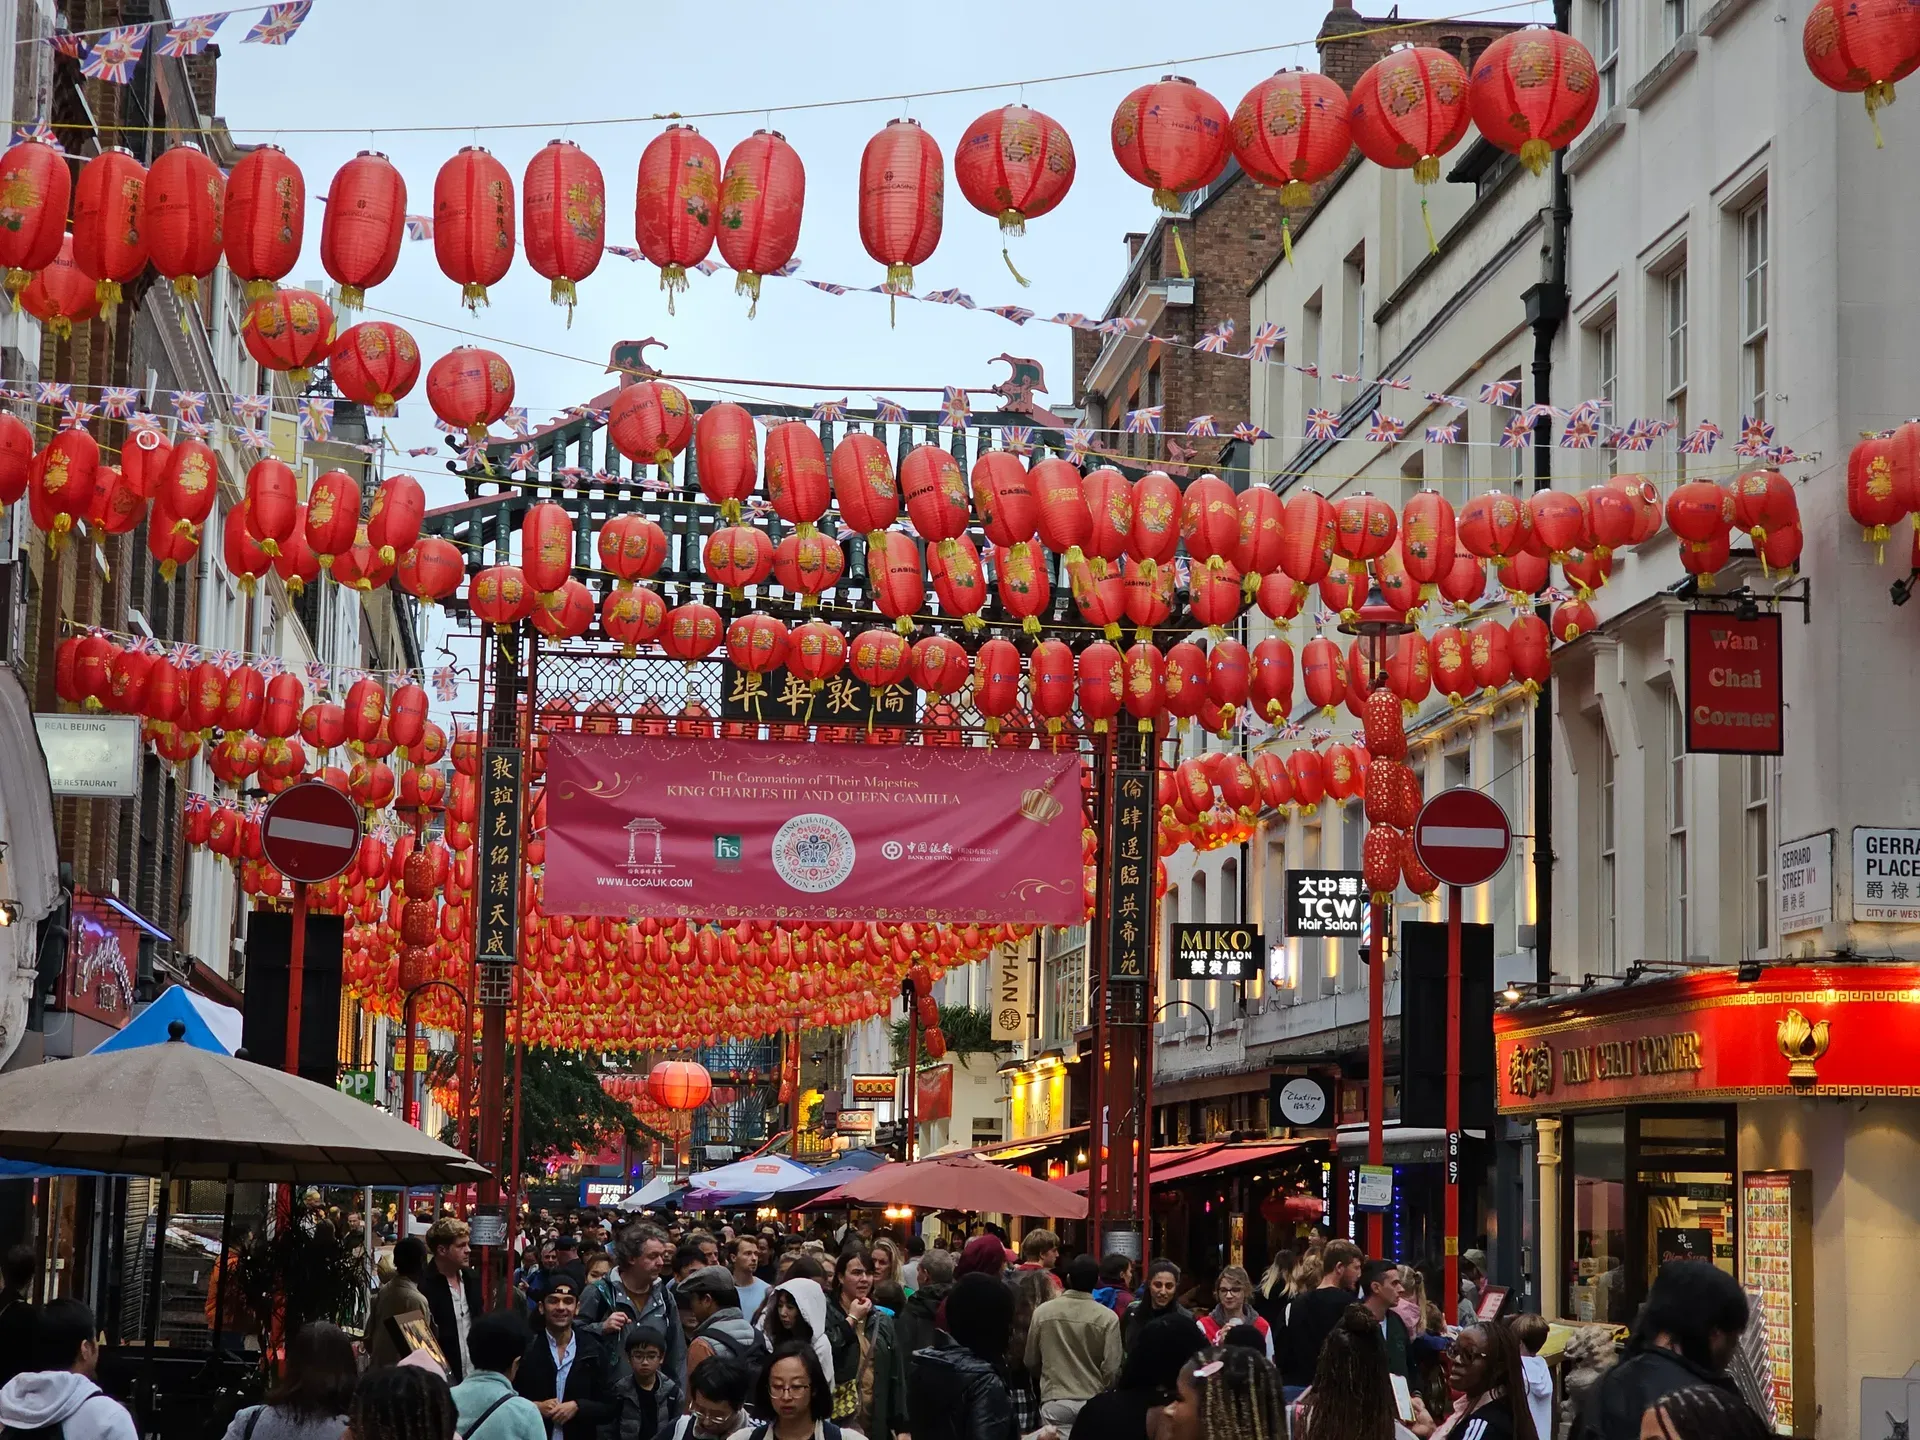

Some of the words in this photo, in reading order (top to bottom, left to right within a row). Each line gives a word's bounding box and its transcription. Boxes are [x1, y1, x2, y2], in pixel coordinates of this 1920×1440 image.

[1709, 629, 1759, 651] Wan
[1708, 667, 1762, 689] Chai
[1694, 705, 1776, 727] Corner
[44, 722, 68, 731] REAL
[70, 723, 106, 732] BEIJING
[709, 770, 733, 782] The
[737, 772, 805, 785] Coronation
[808, 774, 821, 785] of
[827, 775, 860, 787] Their
[864, 776, 919, 789] Majesties
[666, 785, 706, 797] KING
[708, 786, 778, 799] CHARLES
[782, 788, 798, 800] III
[801, 790, 834, 802] AND
[837, 791, 890, 805] QUEEN
[894, 793, 961, 805] CAMILLA
[780, 820, 799, 838] KING
[799, 816, 840, 831] CHARLES
[775, 843, 809, 889] CORONATION
[1782, 846, 1811, 870] GERRARD
[1866, 859, 1920, 877] PLACE
[596, 877, 693, 888] WWW.LCCAUK.COM
[835, 865, 849, 881] MAY
[1782, 869, 1805, 891] STREET
[1807, 867, 1816, 885] W1
[1298, 876, 1366, 897] 大中華
[1866, 881, 1920, 899] 爵禄
[1299, 898, 1357, 919] TCW
[1866, 909, 1884, 918] CITY
[1887, 909, 1898, 918] OF
[1901, 909, 1920, 919] WES
[1298, 918, 1322, 931] Hair
[1325, 918, 1358, 931] Salon
[1180, 930, 1252, 950] MIKO
[1180, 951, 1208, 960] HAIR
[1214, 951, 1252, 960] SALON
[1561, 1046, 1591, 1085] WAN
[1595, 1041, 1634, 1080] CHAI
[1637, 1031, 1703, 1076] CORNER
[1691, 1187, 1710, 1197] Exit
